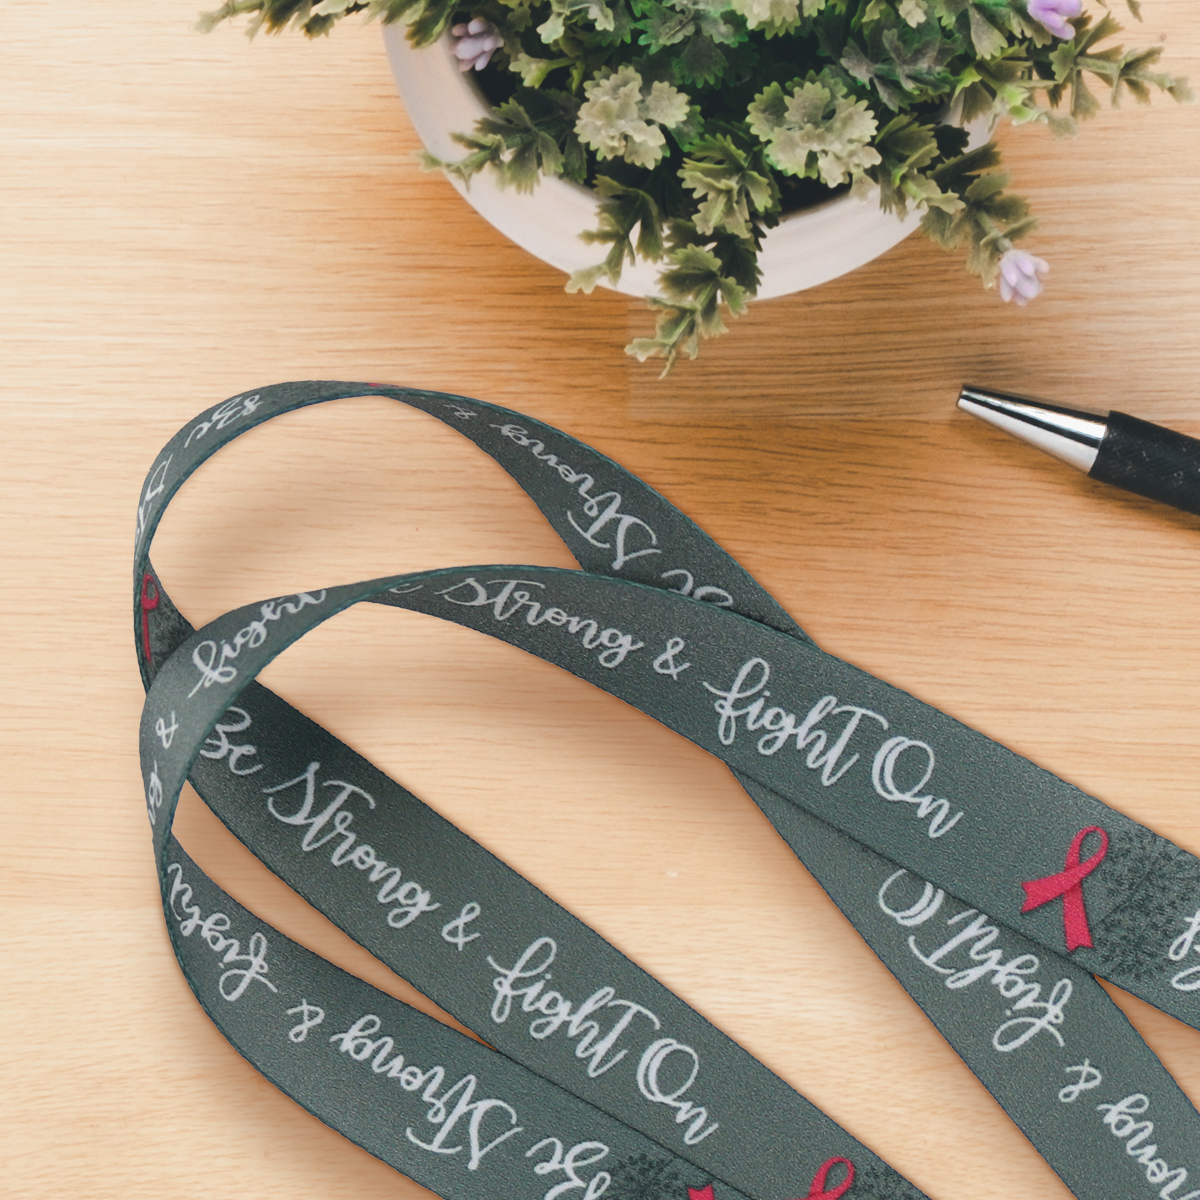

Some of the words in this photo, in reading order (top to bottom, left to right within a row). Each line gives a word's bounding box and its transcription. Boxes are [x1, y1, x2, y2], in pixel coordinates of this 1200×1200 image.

[653, 637, 690, 681] &
[872, 736, 965, 839] On
[286, 998, 325, 1043] &
[441, 902, 481, 951] &
[636, 1038, 719, 1145] On
[1058, 1058, 1102, 1102] &
